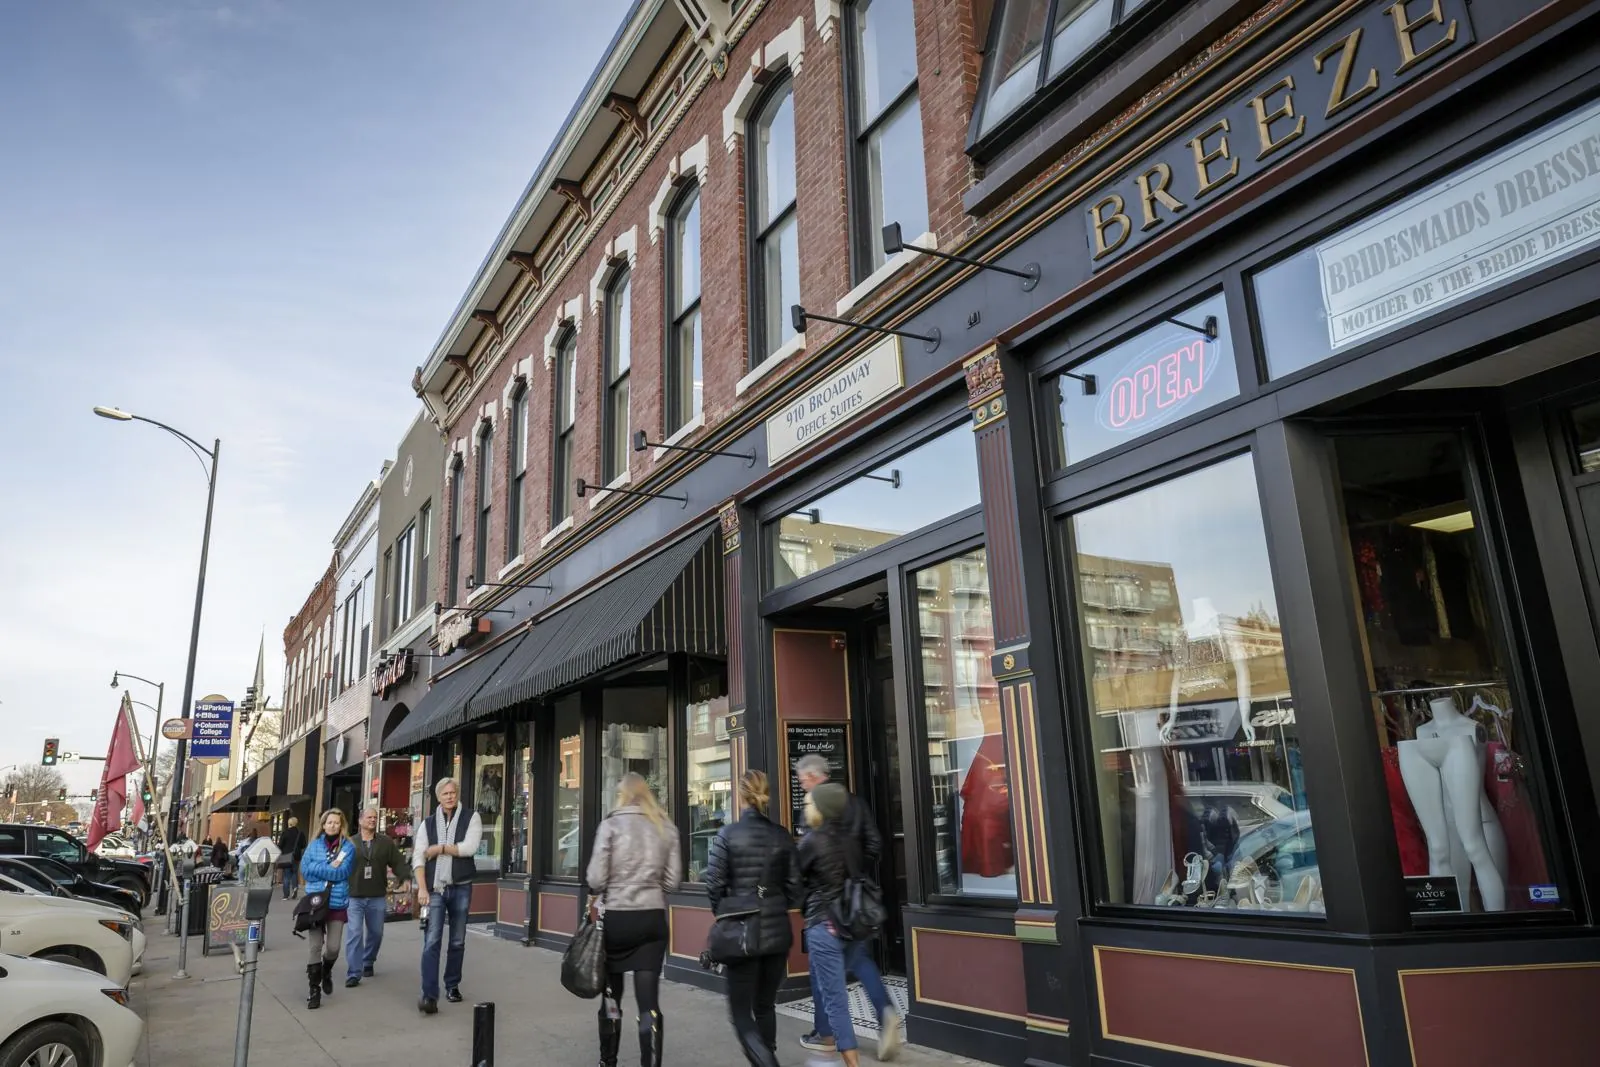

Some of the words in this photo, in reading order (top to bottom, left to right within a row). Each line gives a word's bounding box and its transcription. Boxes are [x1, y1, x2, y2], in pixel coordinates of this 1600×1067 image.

[1087, 0, 1457, 261] BREEZE
[1327, 190, 1490, 296] BRIDESMAIDS
[1341, 294, 1409, 335] MOTHER
[1413, 282, 1434, 305] OF
[1438, 266, 1475, 295] THE
[1477, 236, 1539, 280] BRIDE
[786, 404, 804, 428] 910
[809, 360, 871, 414] BROADWAY
[796, 415, 827, 441] OFFICE
[830, 390, 863, 421] SUITES
[1109, 340, 1205, 428] OPEN
[209, 704, 231, 712] Parking
